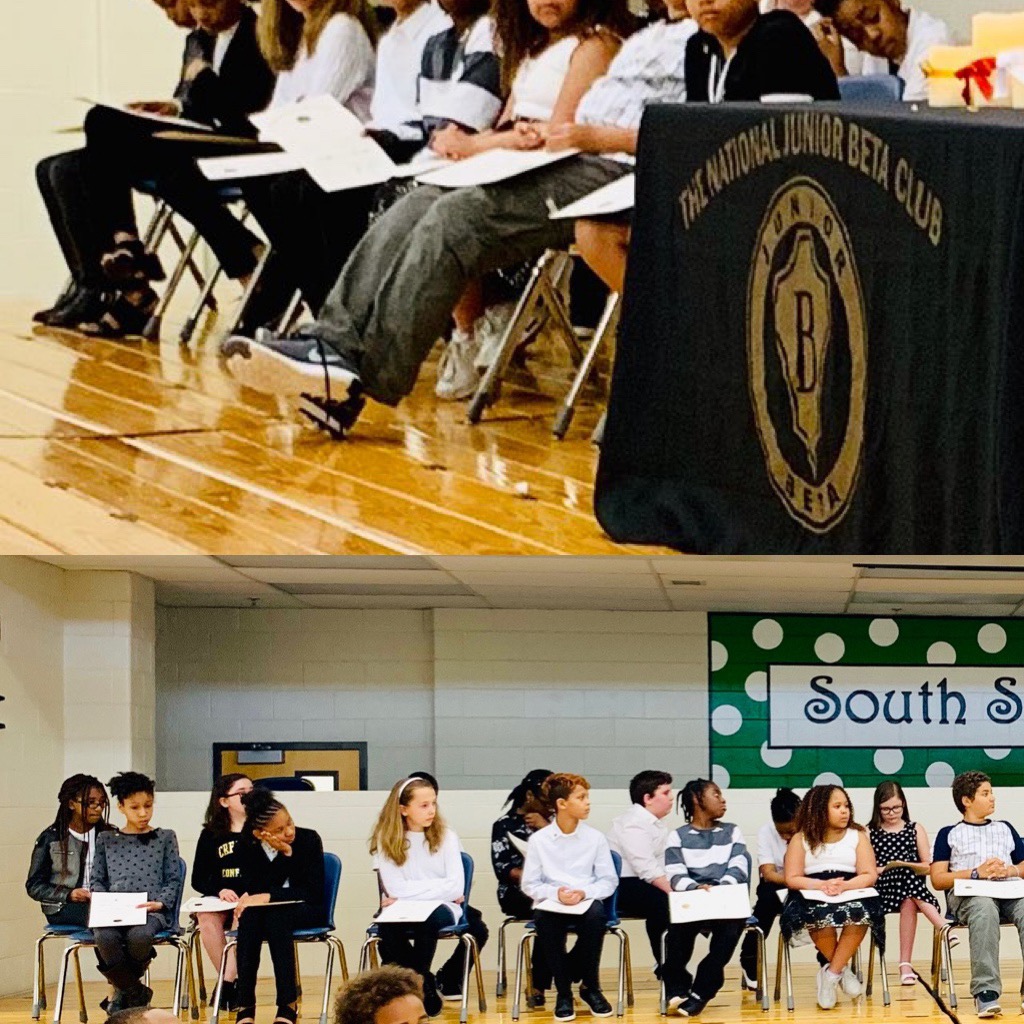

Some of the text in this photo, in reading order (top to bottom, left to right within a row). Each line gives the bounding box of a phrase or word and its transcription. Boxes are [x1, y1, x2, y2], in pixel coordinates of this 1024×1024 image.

[678, 112, 944, 247] THE NATIONAL JUNIOR BETA CLUB
[761, 192, 847, 277] JUNIOR
[793, 290, 818, 394] B
[785, 474, 841, 517] BETA
[804, 675, 967, 725] South
